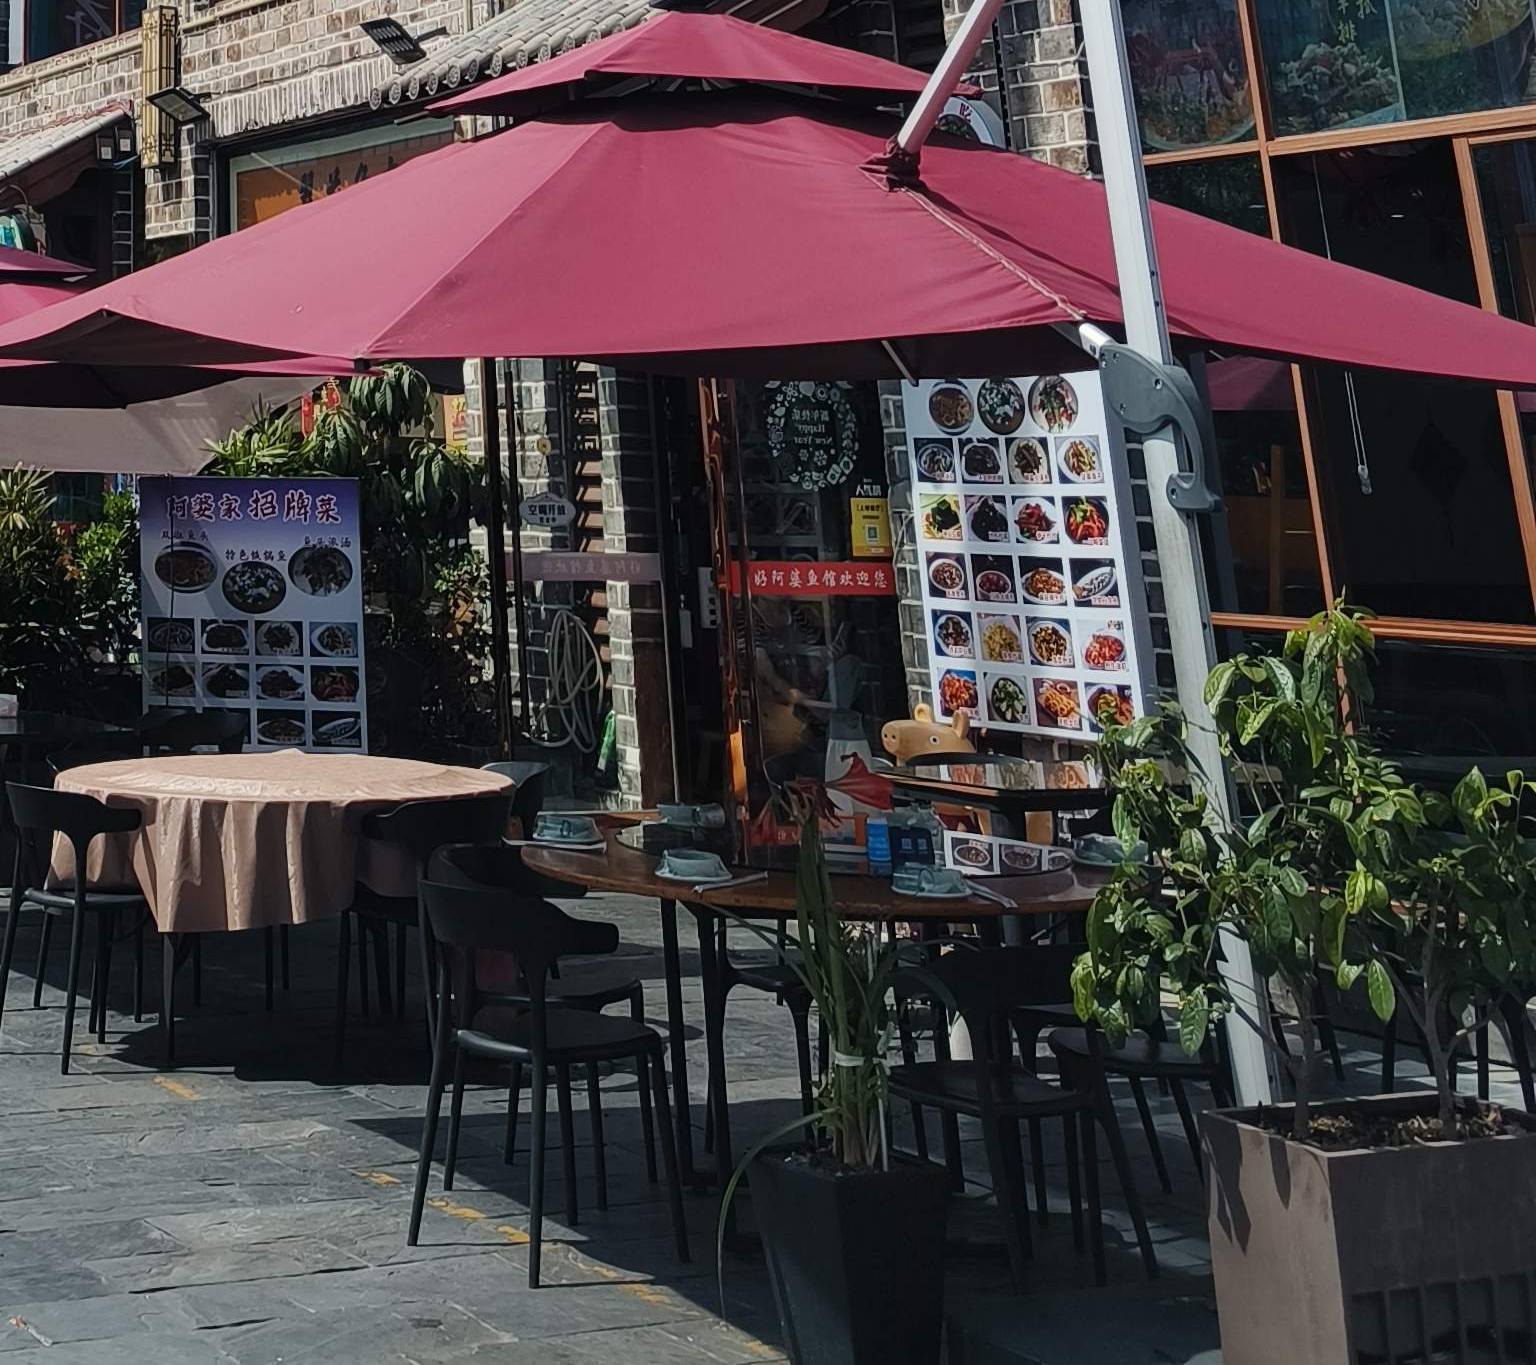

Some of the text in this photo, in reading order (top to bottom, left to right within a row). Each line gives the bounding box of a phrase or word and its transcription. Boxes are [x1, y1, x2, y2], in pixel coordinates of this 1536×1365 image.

[167, 489, 342, 525] 阿婆家招牌菜
[754, 568, 888, 589] 好阿婆鱼馆欢迎您
